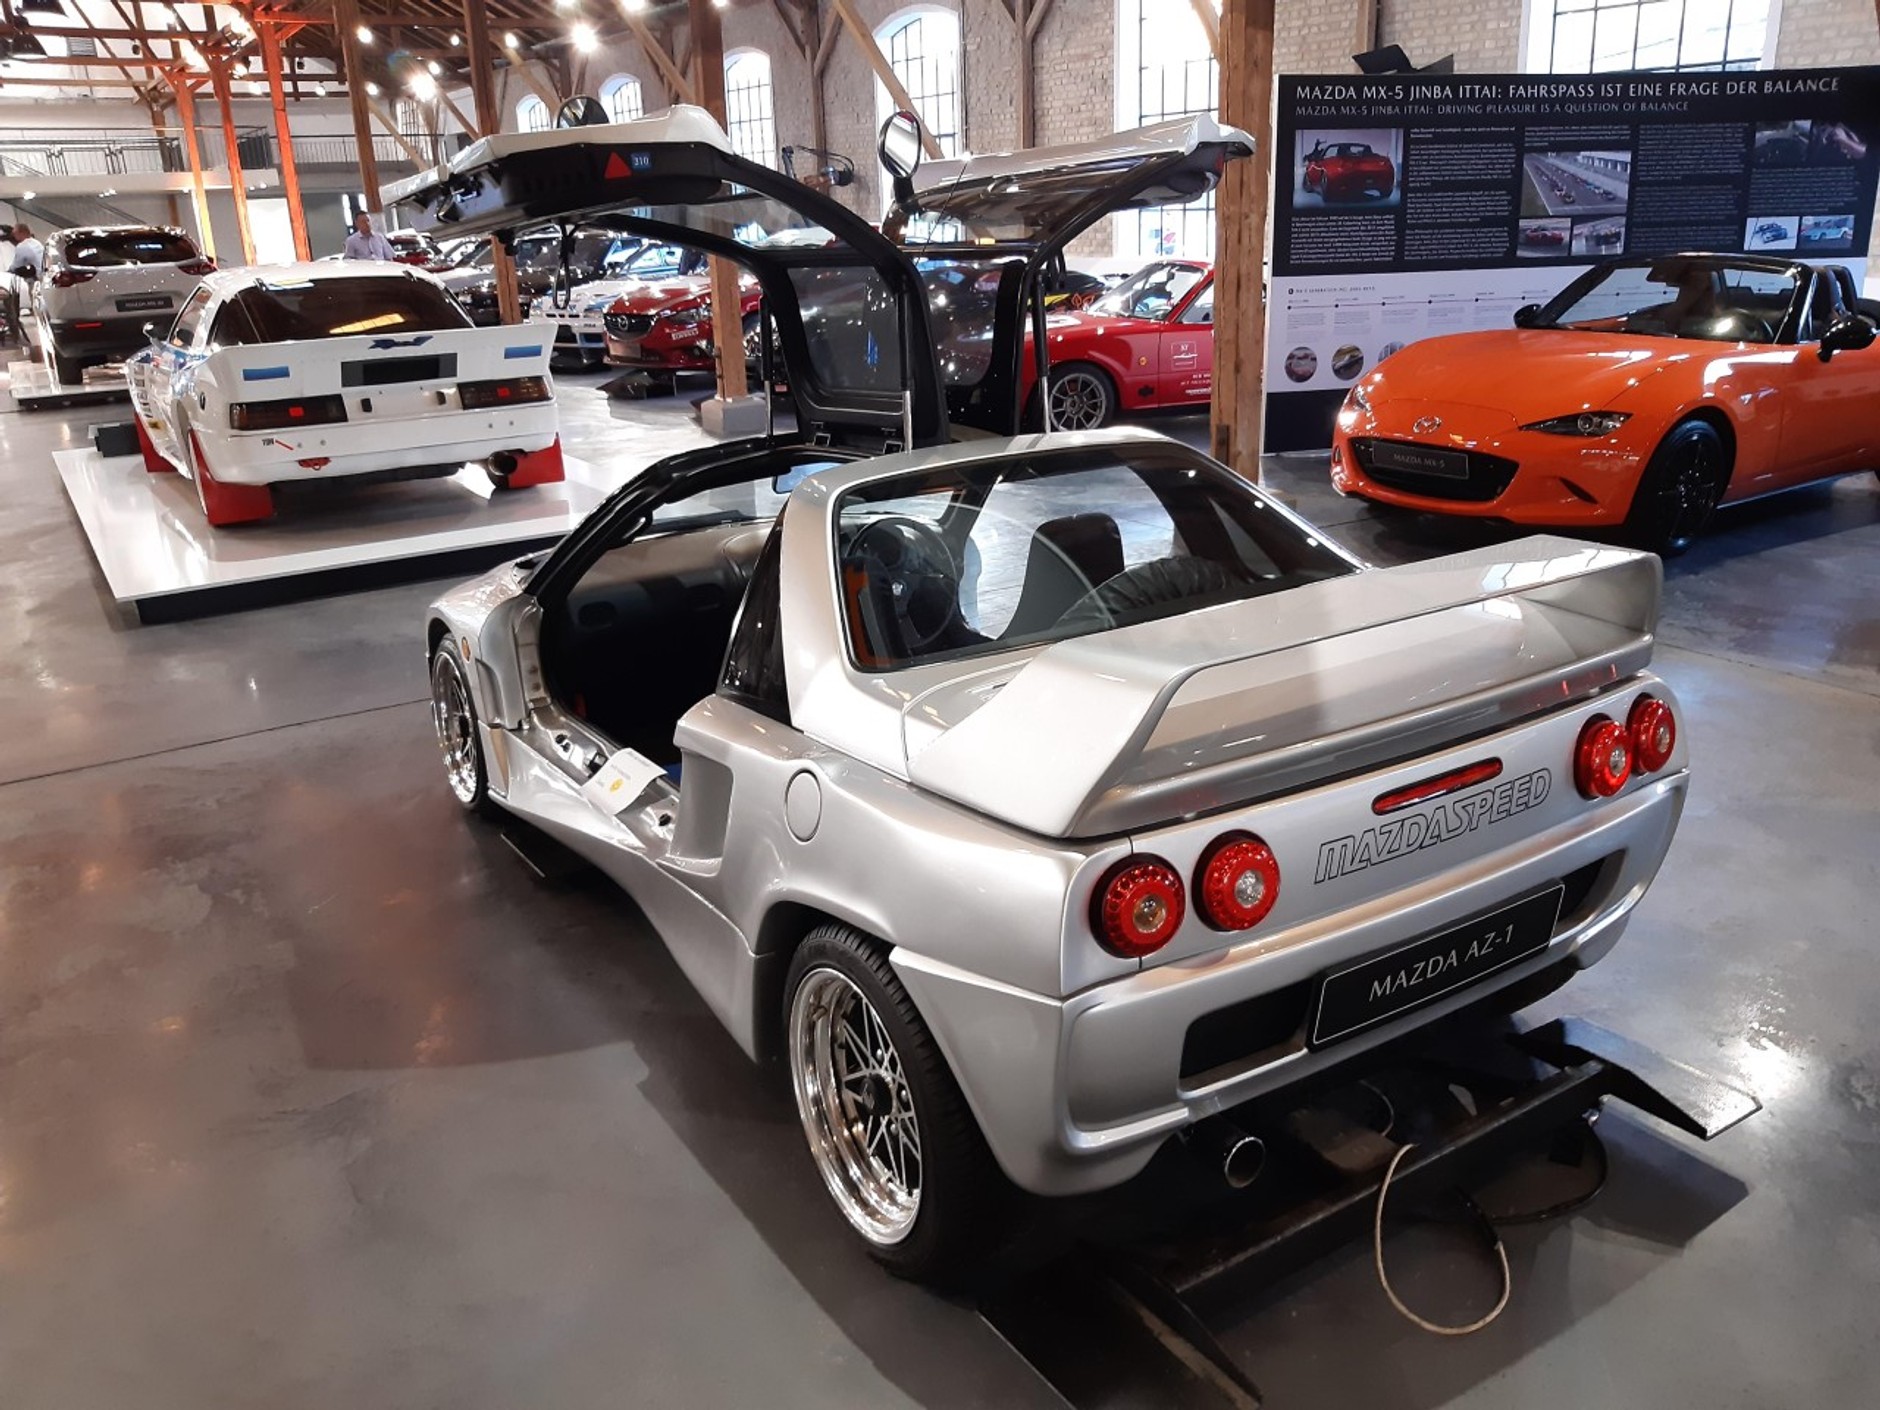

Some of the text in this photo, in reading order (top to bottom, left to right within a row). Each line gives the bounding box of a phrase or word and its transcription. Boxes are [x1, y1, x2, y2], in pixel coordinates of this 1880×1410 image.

[1296, 77, 1840, 100] MAZDA MX-5 JINBA ITTAI: FAHRSPASS IST EINE FRAGE DER BALANCE
[1295, 101, 1689, 116] MAZDA MX-5 JINBA ITTAI: DRIVING PLEASURE IS A QUESTION OF BALANCE
[1393, 453, 1422, 465] MAZDA
[1314, 767, 1552, 885] MAZDASPEED
[1369, 924, 1515, 1001] MAZDA AZ-1
